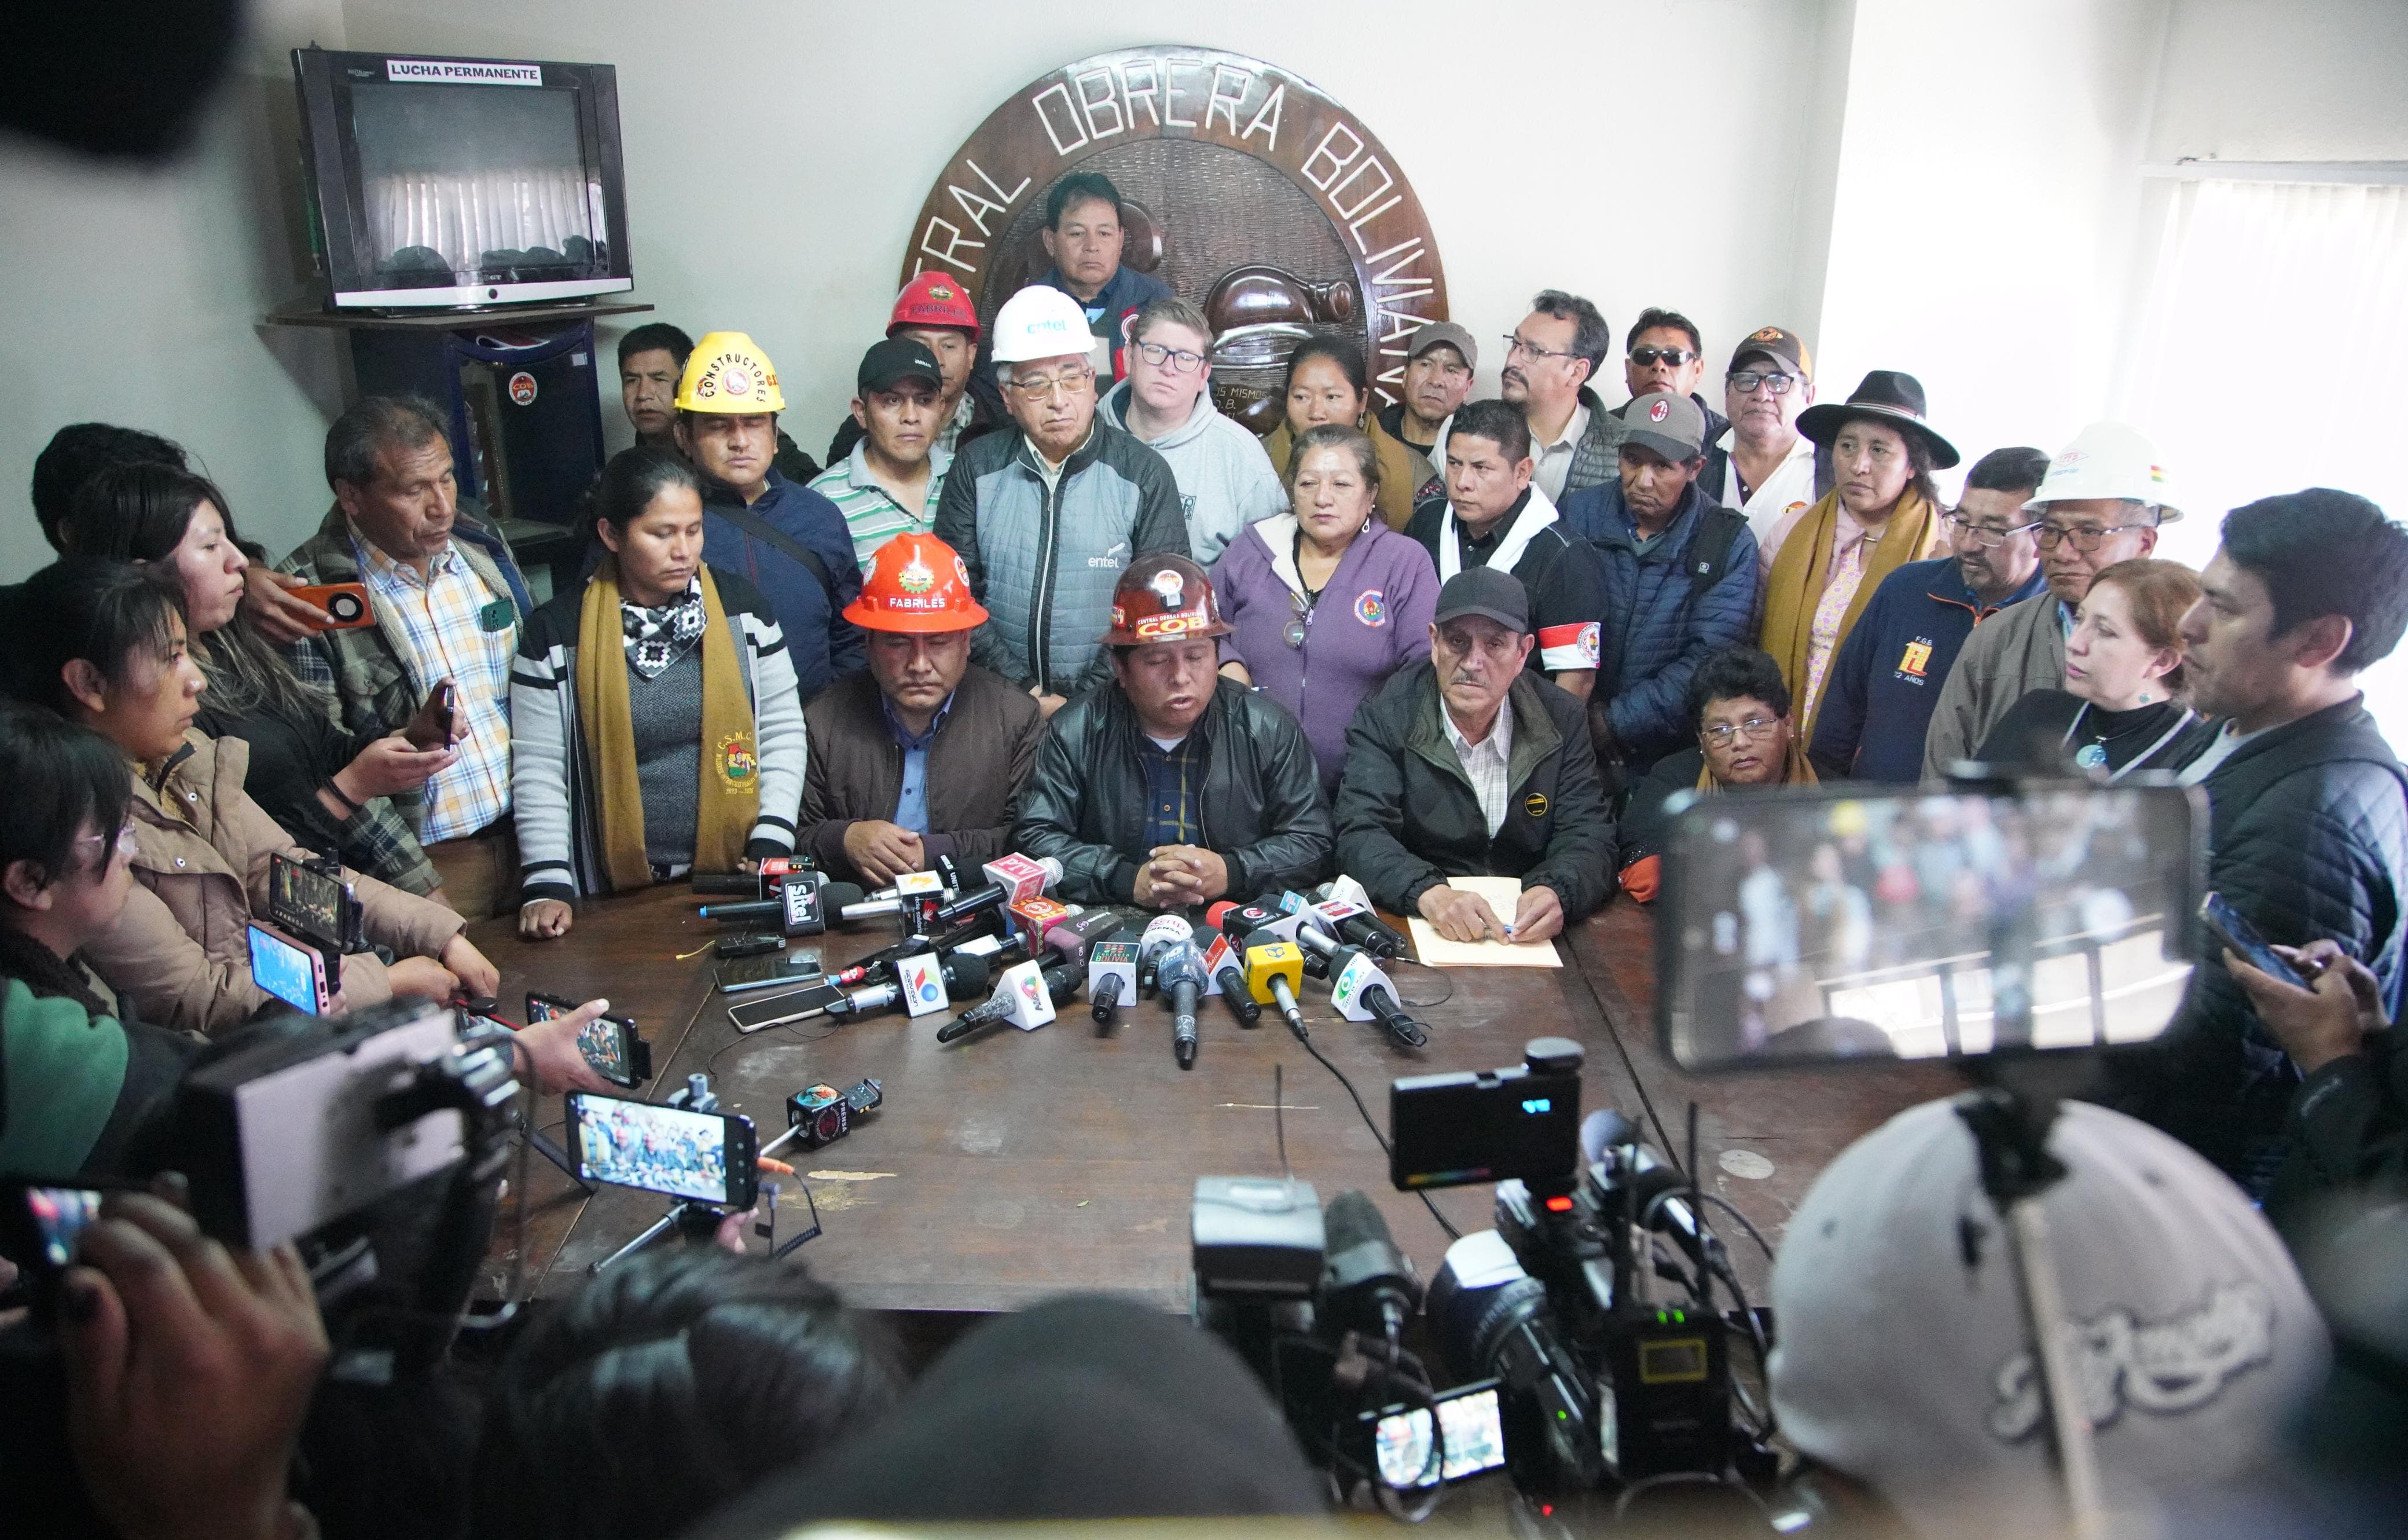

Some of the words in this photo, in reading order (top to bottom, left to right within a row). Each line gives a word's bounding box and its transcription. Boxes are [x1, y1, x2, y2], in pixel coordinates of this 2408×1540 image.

[391, 64, 442, 76] LUCHA
[445, 66, 539, 80] PERMANENTE
[913, 157, 1032, 294] RAL
[1032, 57, 1286, 156] OBRERA
[703, 353, 766, 404] CONSTRUCTORES
[1088, 556, 1119, 568] entel
[890, 597, 945, 608] FABRILES
[1137, 617, 1158, 625] CENTRAL
[1159, 613, 1180, 622] OBRERA
[1138, 616, 1206, 636] COB
[1903, 674, 1925, 685] AÑOS
[999, 858, 1039, 876] PTV
[793, 884, 811, 922] Sitel
